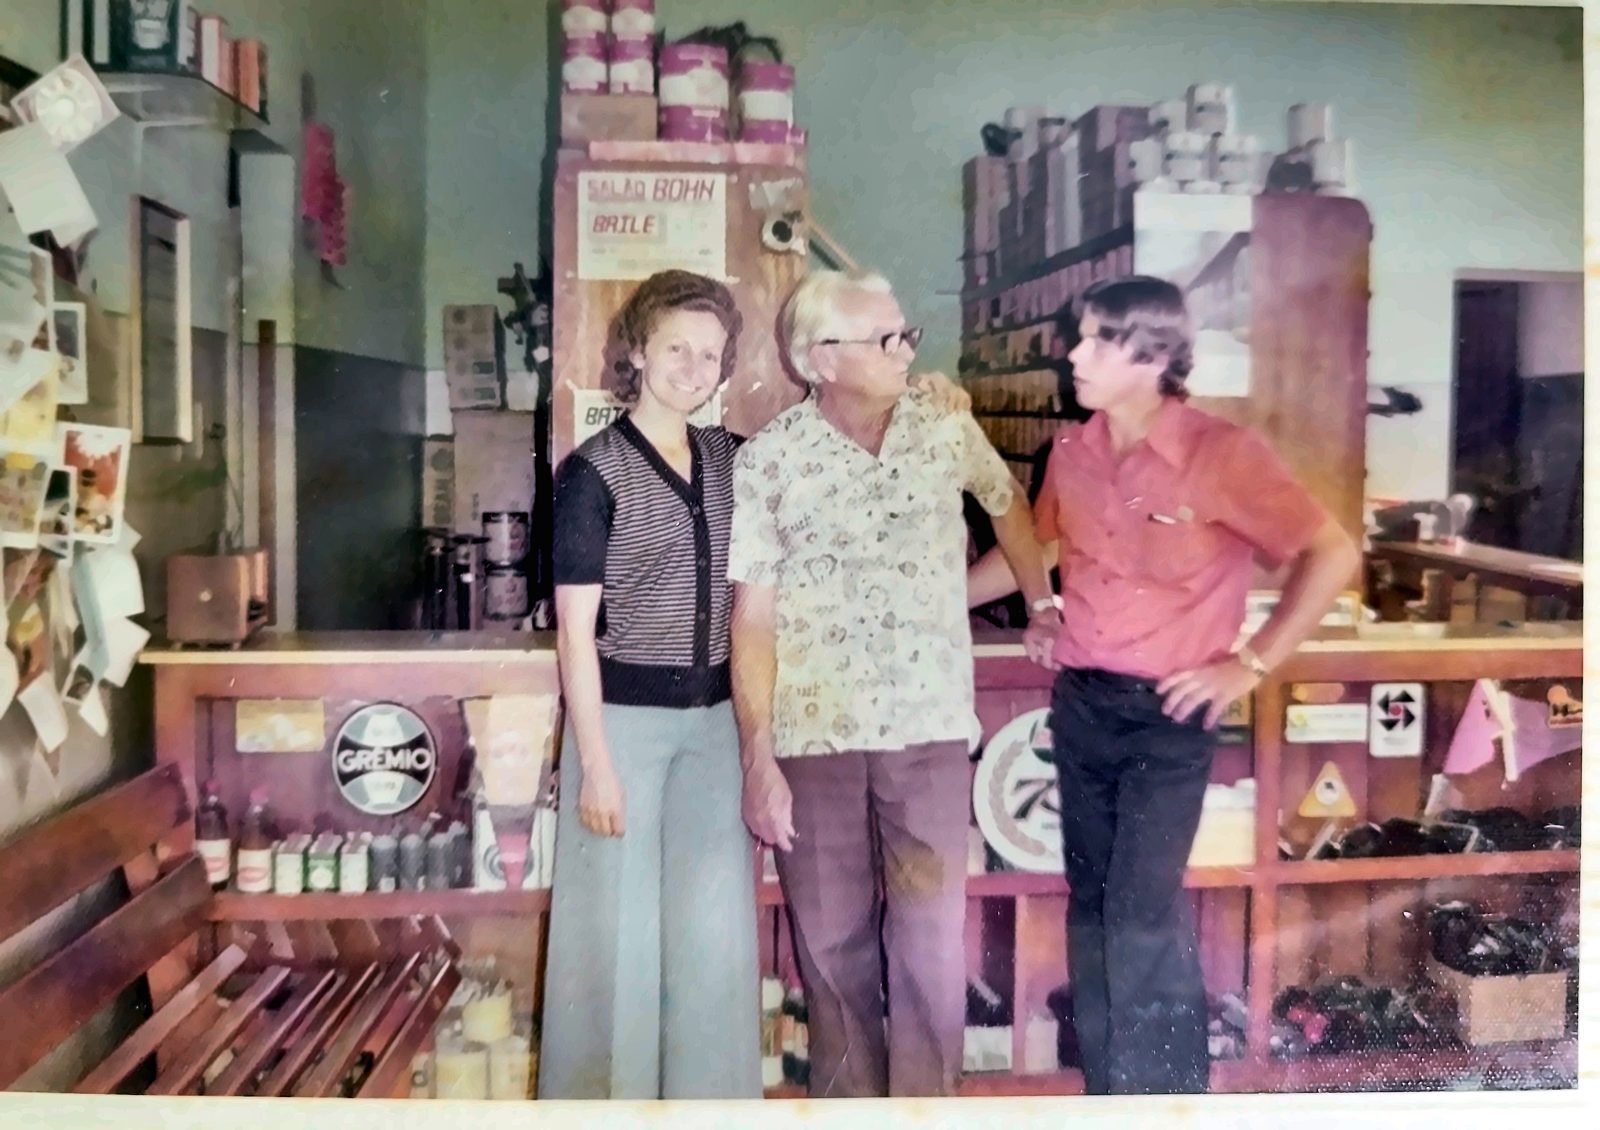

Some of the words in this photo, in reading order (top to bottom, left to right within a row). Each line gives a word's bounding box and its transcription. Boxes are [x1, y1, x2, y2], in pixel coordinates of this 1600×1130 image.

[652, 178, 716, 202] BOHN
[592, 214, 656, 234] BAILE
[584, 406, 628, 426] BAI
